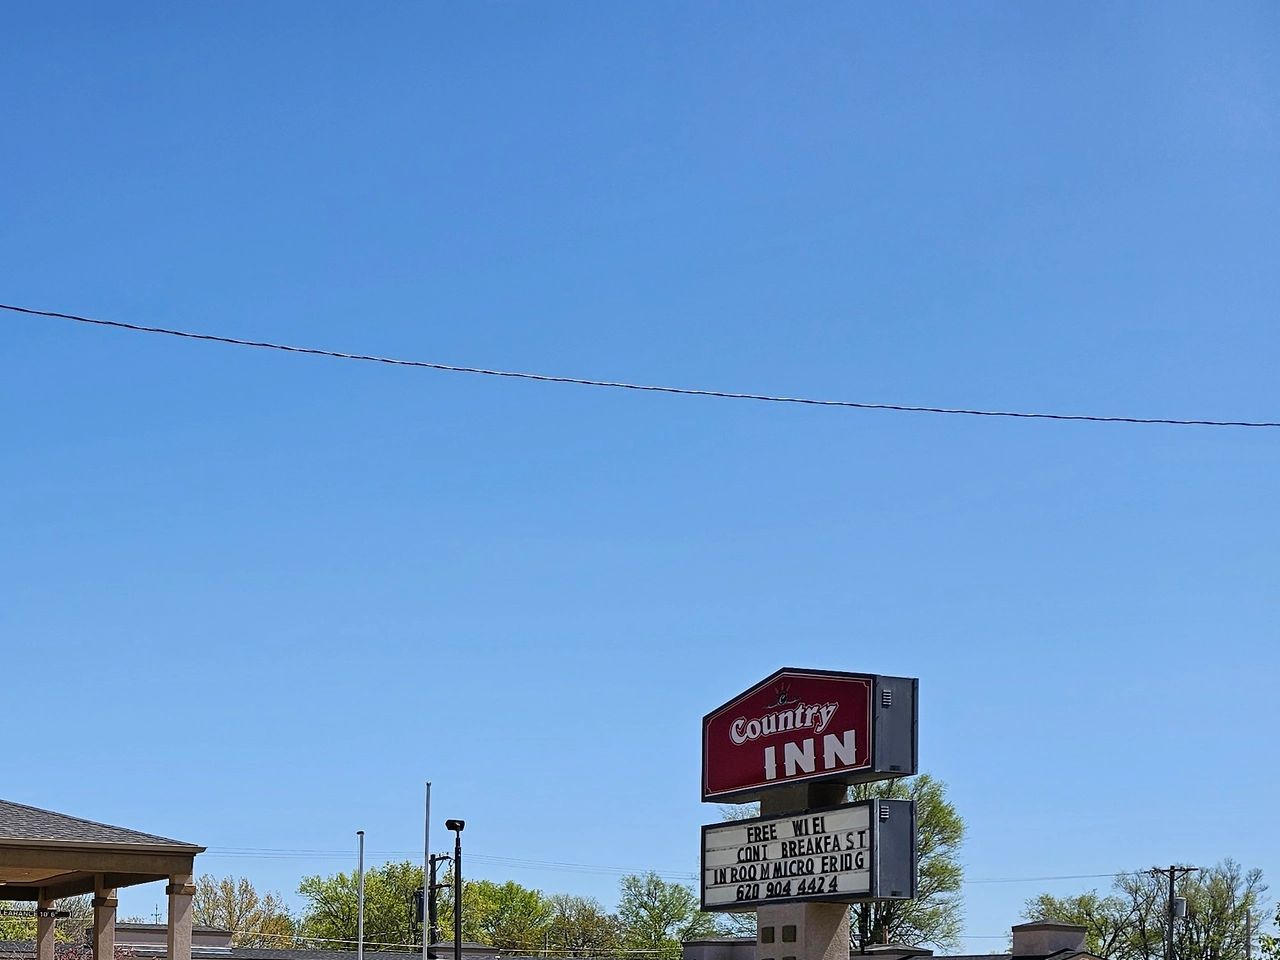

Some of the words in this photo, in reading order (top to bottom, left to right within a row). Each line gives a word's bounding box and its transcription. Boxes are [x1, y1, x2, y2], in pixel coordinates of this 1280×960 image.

[730, 702, 838, 746] Country
[765, 730, 857, 780] INN
[737, 844, 768, 864] CONT
[781, 831, 866, 859] BREAKFAST
[747, 824, 778, 844] FREE
[714, 868, 727, 886] IN
[730, 863, 770, 884] ROOM
[772, 857, 815, 879] MICRO
[736, 883, 760, 901] 620
[765, 880, 792, 898] 904
[797, 876, 838, 895] 4424
